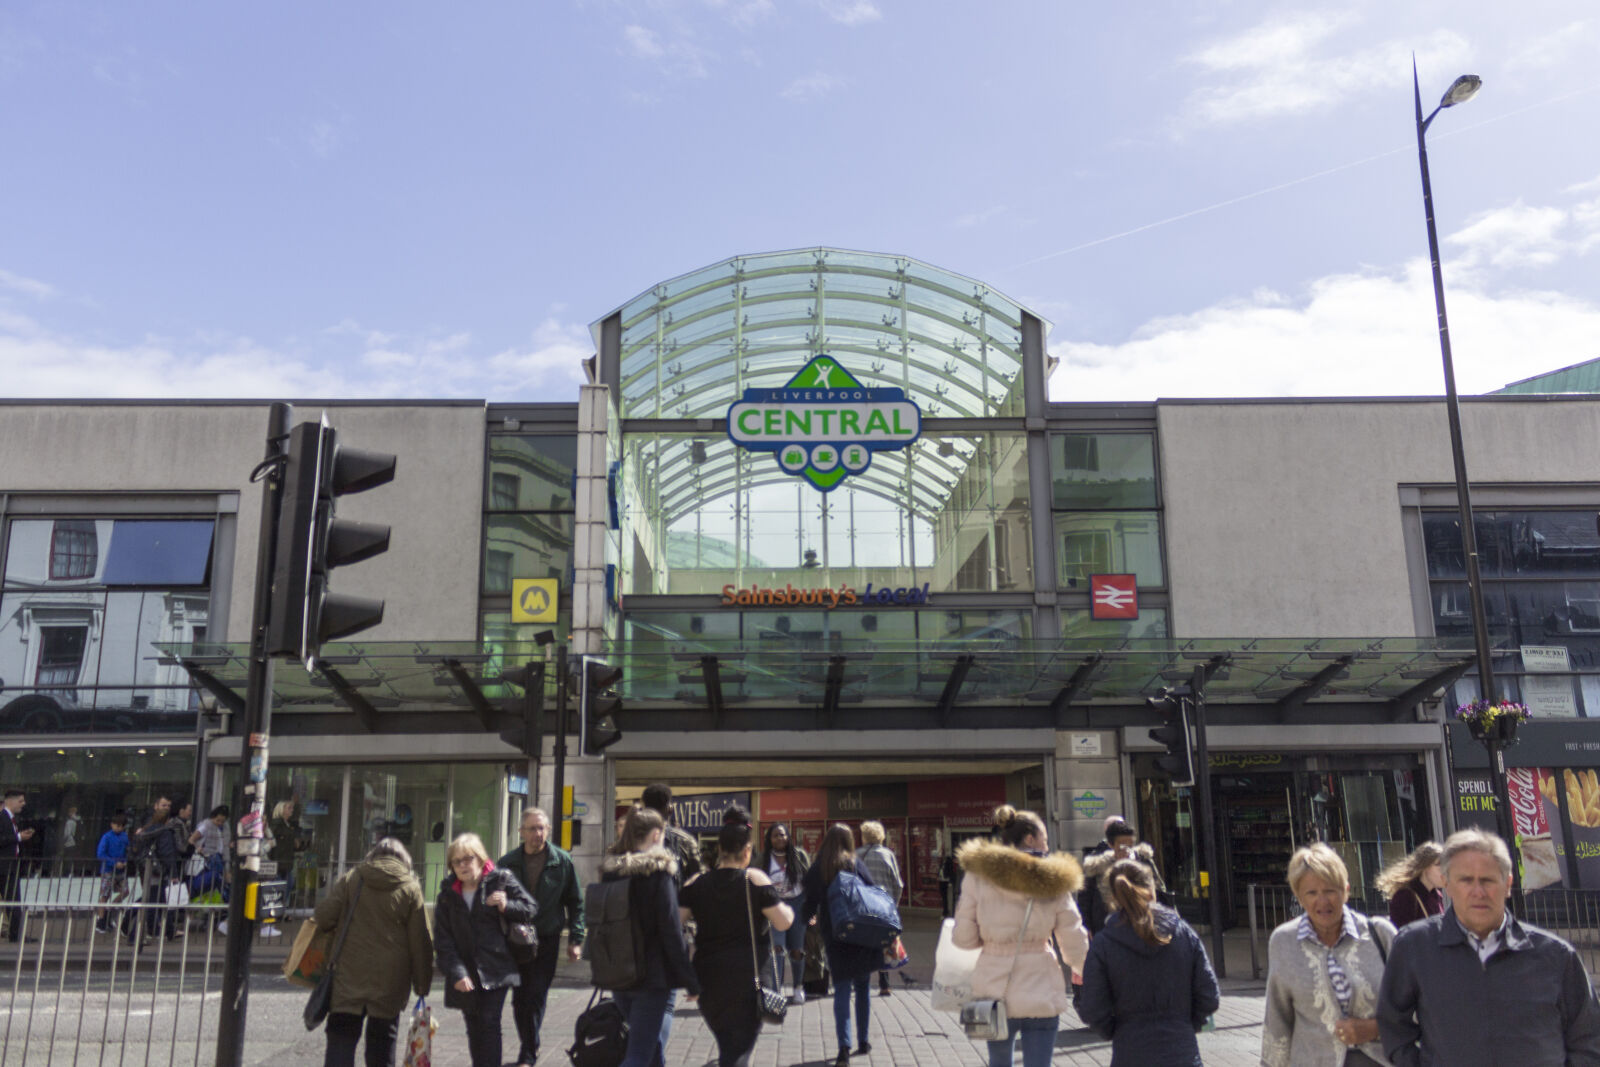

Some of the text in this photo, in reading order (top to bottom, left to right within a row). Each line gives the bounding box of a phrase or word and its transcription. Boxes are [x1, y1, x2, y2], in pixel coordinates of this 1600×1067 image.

[772, 391, 873, 400] LIVERPOOL
[737, 408, 913, 436] CENTRAL
[721, 582, 930, 608] Sainsbury's Local
[1458, 780, 1486, 793] SPEND
[1460, 796, 1478, 811] EAT
[1538, 799, 1546, 825] classic
